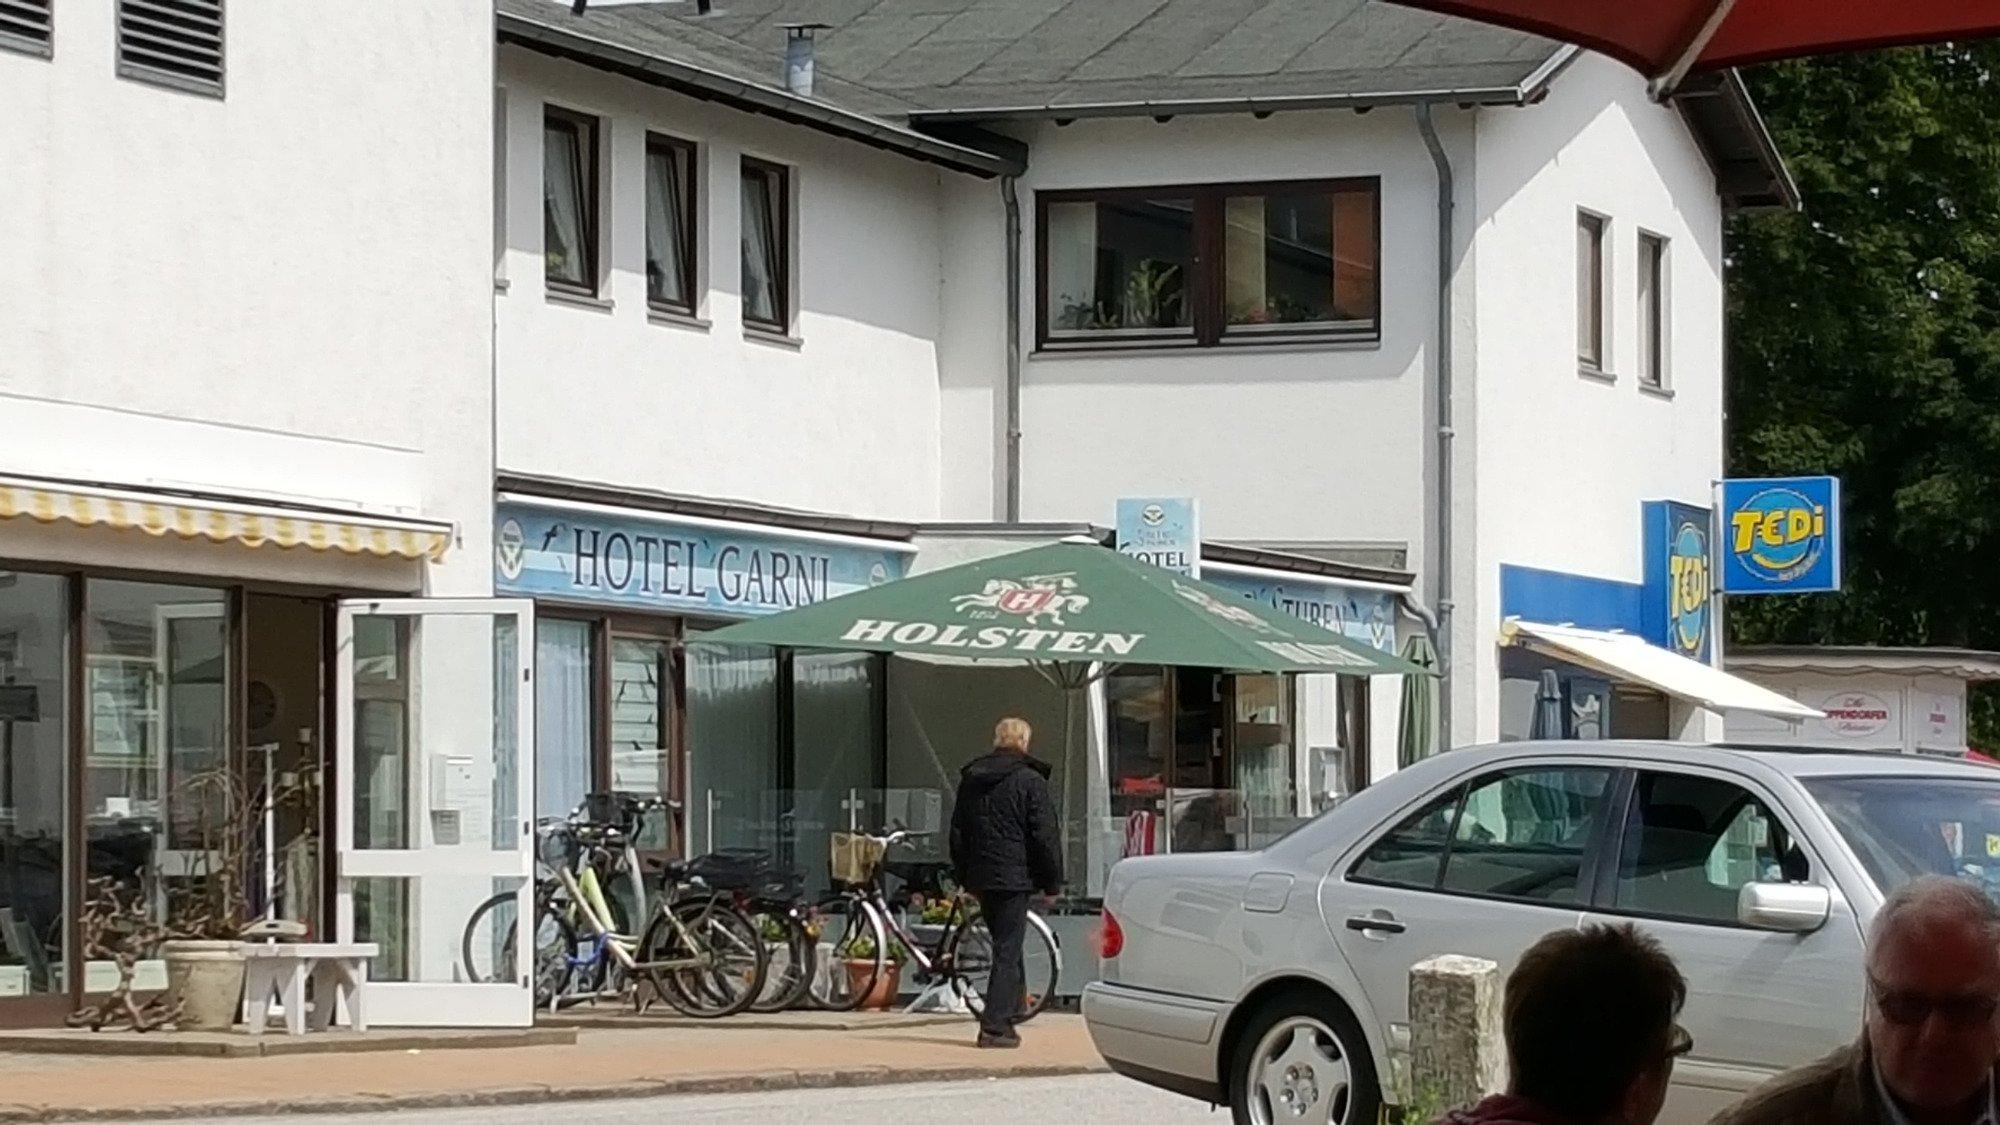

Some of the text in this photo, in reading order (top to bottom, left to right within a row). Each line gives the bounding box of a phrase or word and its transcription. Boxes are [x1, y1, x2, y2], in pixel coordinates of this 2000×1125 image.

[572, 527, 830, 606] HOTEL GARNI
[1128, 552, 1190, 567] OTEL
[841, 619, 1145, 655] HOLSTEN
